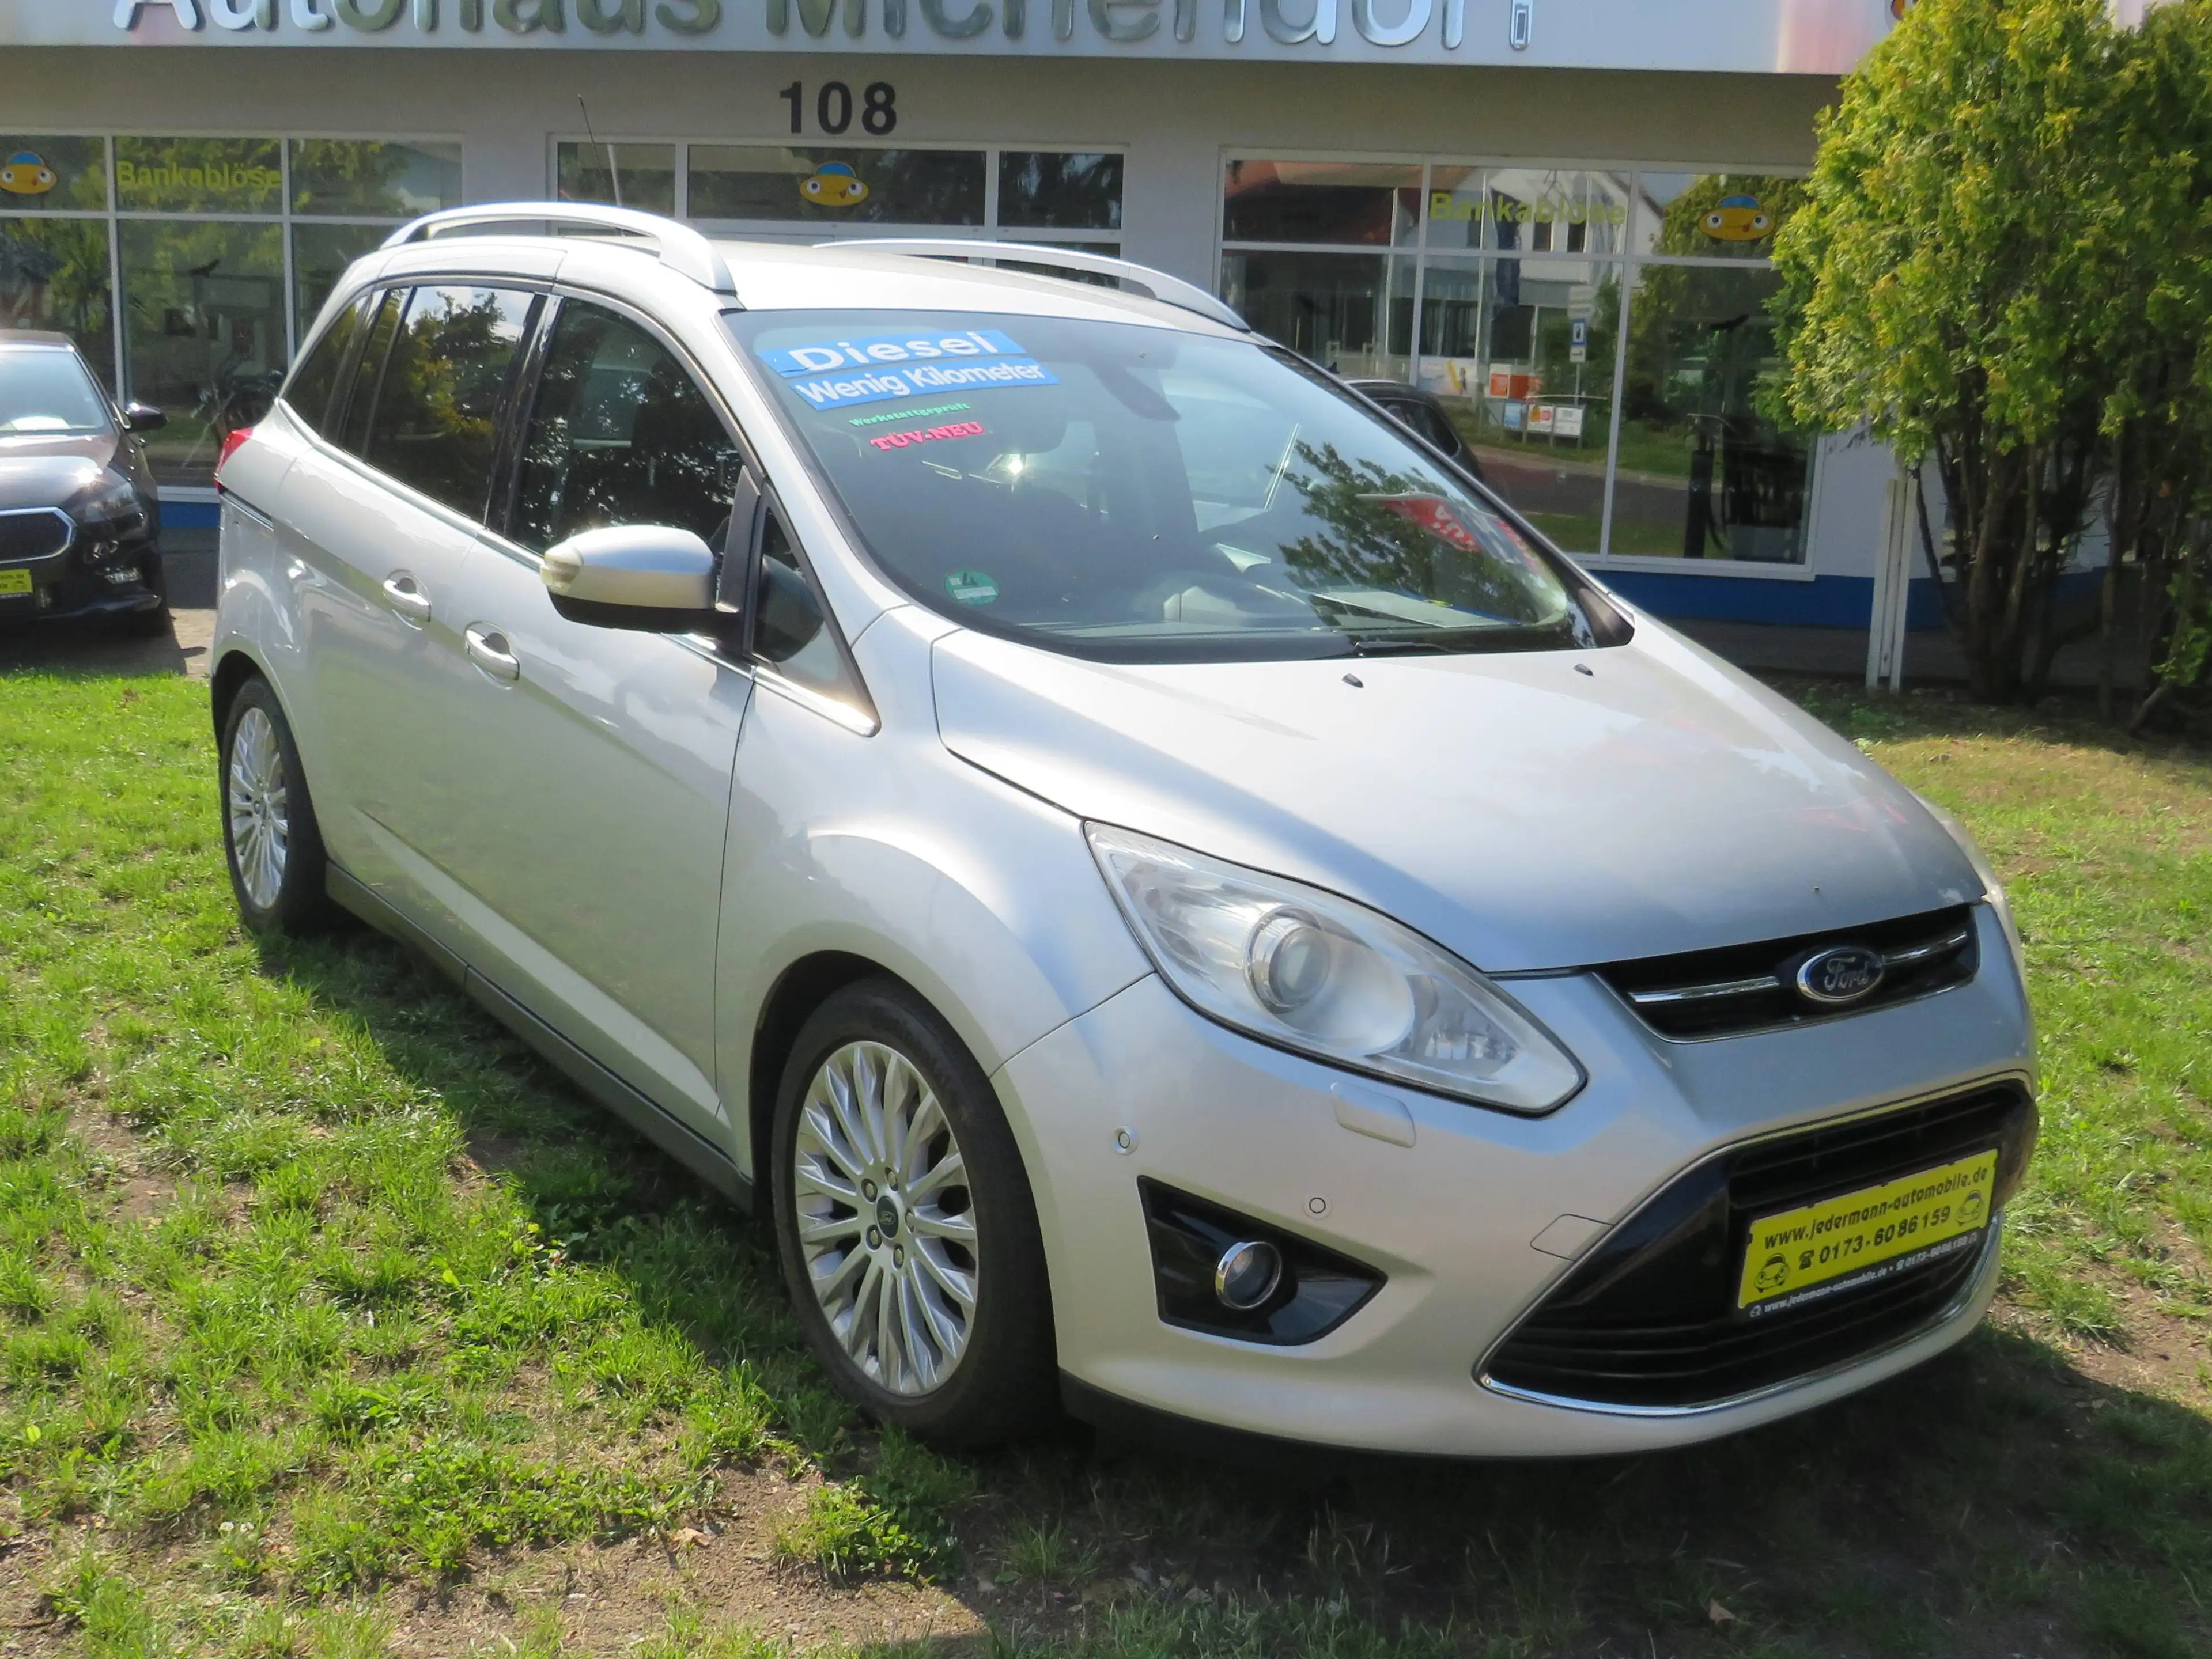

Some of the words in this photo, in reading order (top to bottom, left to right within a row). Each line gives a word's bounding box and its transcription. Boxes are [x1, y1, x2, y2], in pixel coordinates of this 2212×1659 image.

[780, 80, 897, 135] 108
[788, 331, 999, 371] Diesel
[796, 372, 910, 403] Wenig
[902, 362, 1046, 388] Kilometer
[869, 421, 983, 451] TÜV-NEU
[1824, 956, 1871, 991] Ford
[1764, 1166, 1987, 1250] www.jedermann-automobile.de
